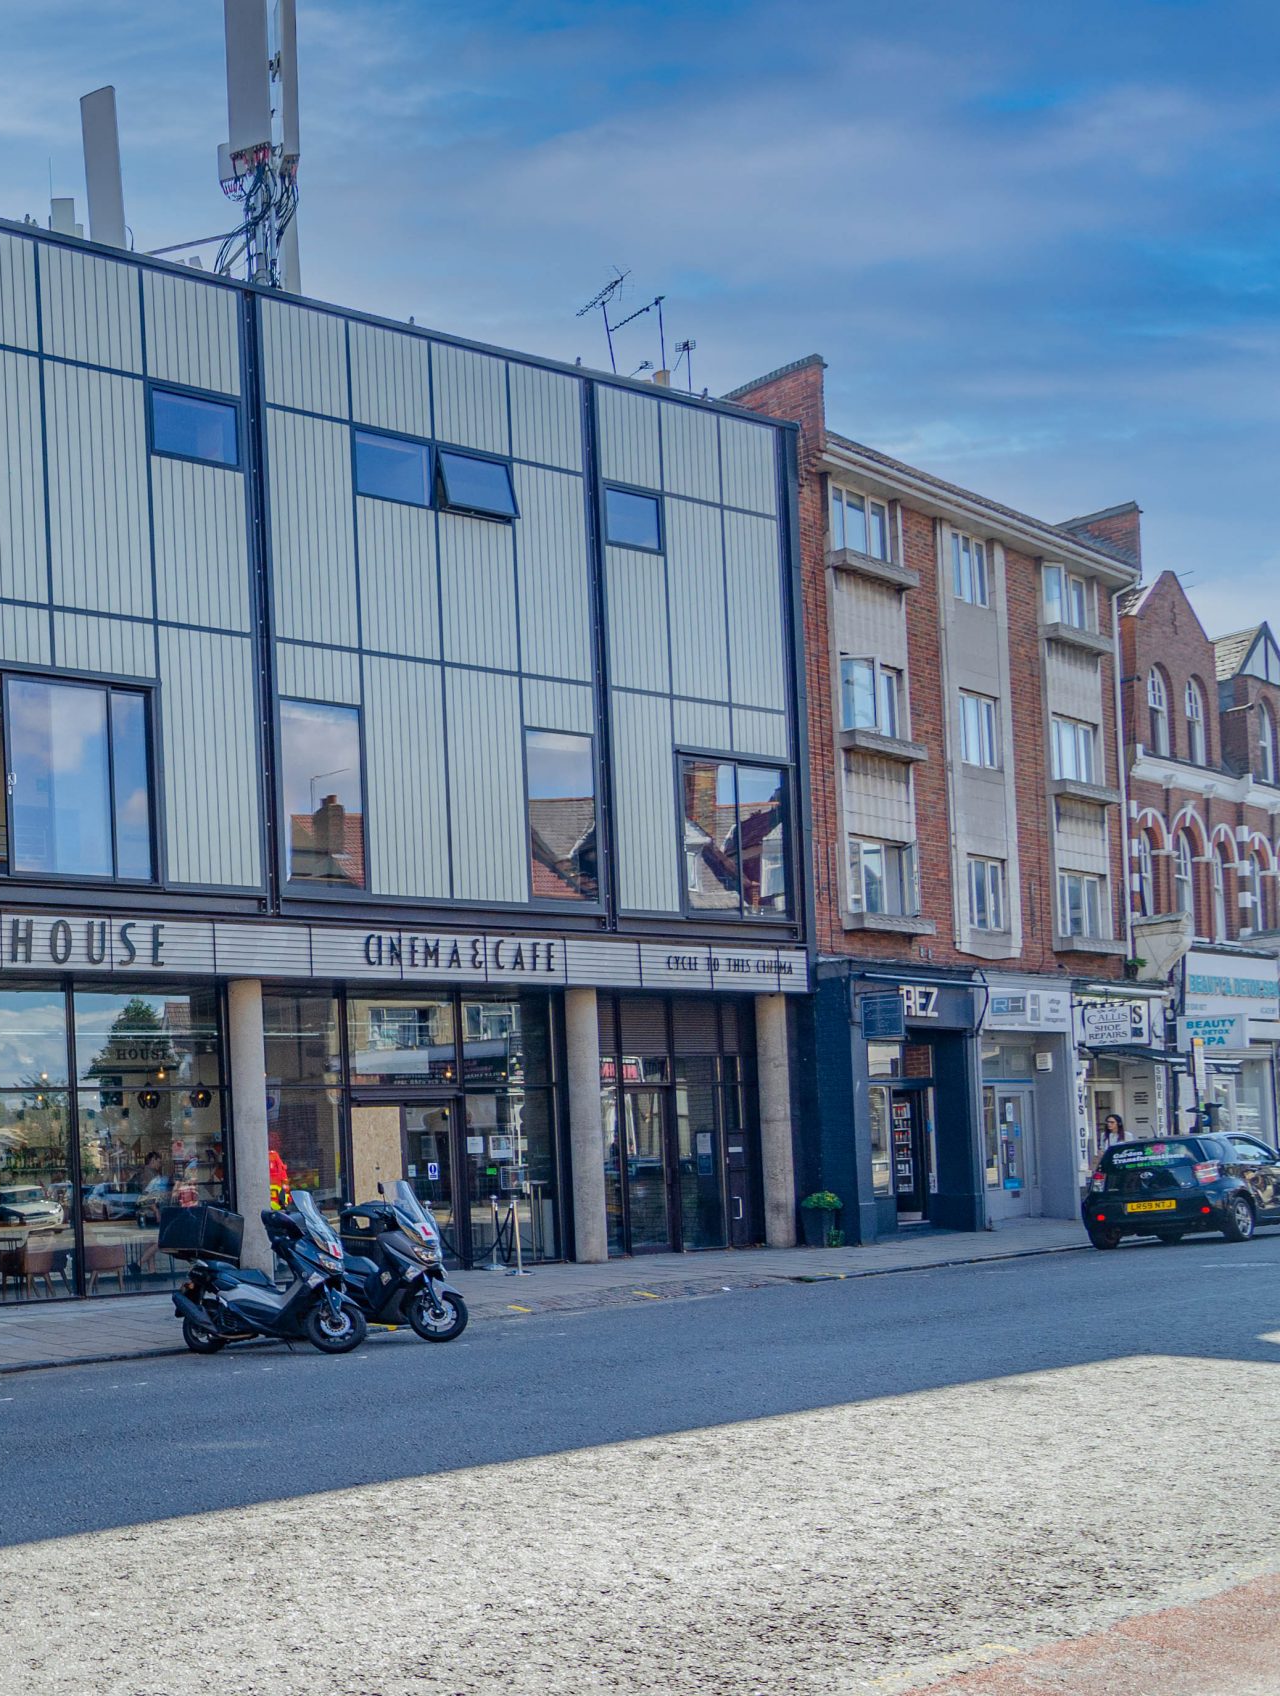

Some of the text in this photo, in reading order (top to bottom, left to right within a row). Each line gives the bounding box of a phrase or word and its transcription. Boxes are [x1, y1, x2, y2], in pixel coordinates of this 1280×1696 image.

[667, 955, 793, 975] CYCLE TO THIS CINEMA
[899, 984, 939, 1018] REZ
[1087, 1013, 1128, 1025] CALLIS
[1186, 1019, 1236, 1029] BEAUTY
[1094, 1024, 1121, 1032] SHOE
[1089, 1031, 1128, 1040] REPAIRS
[1112, 1148, 1143, 1159] Garden
[1112, 1153, 1186, 1165] Transformations
[421, 1226, 432, 1236] L
[332, 1245, 341, 1257] L
